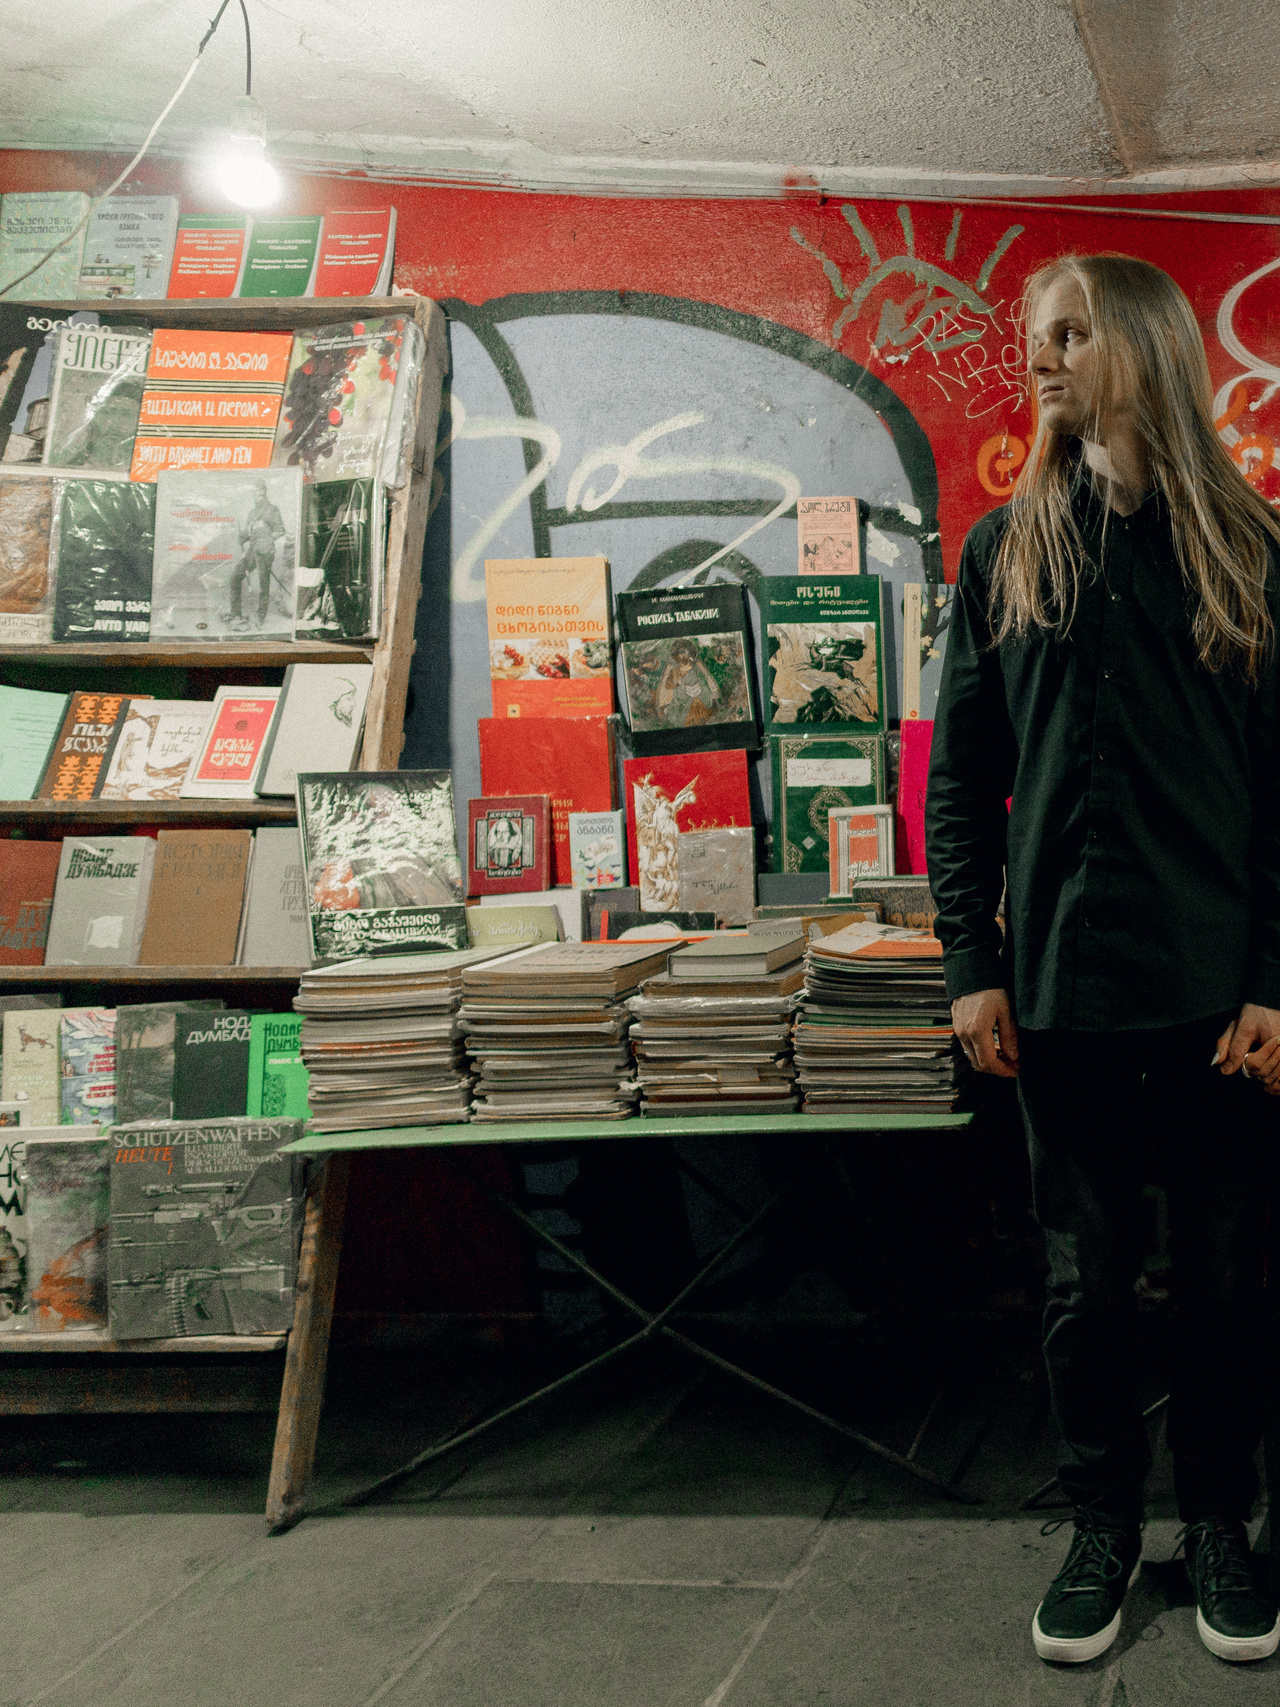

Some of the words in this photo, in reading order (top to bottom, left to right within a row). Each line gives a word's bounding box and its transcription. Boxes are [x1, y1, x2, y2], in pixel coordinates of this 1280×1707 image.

[118, 223, 140, 231] ЯЗЫКА
[147, 401, 202, 417] ШТЫКОМ
[211, 447, 232, 464] AND
[233, 448, 252, 464] PEN
[496, 605, 534, 617] დიდი
[538, 604, 580, 616] წიგნი
[637, 611, 674, 626] РОСПИСЬ
[675, 608, 720, 623] ТАБАКИНИ
[94, 620, 122, 633] AVTO
[497, 619, 604, 634] ცხობისათვის
[576, 824, 614, 836] ანბანი
[65, 862, 140, 879] ДУМБАДЗЕ
[113, 1127, 282, 1149] SCHÜTZENWAFFEN
[115, 1147, 174, 1163] HEUTE
